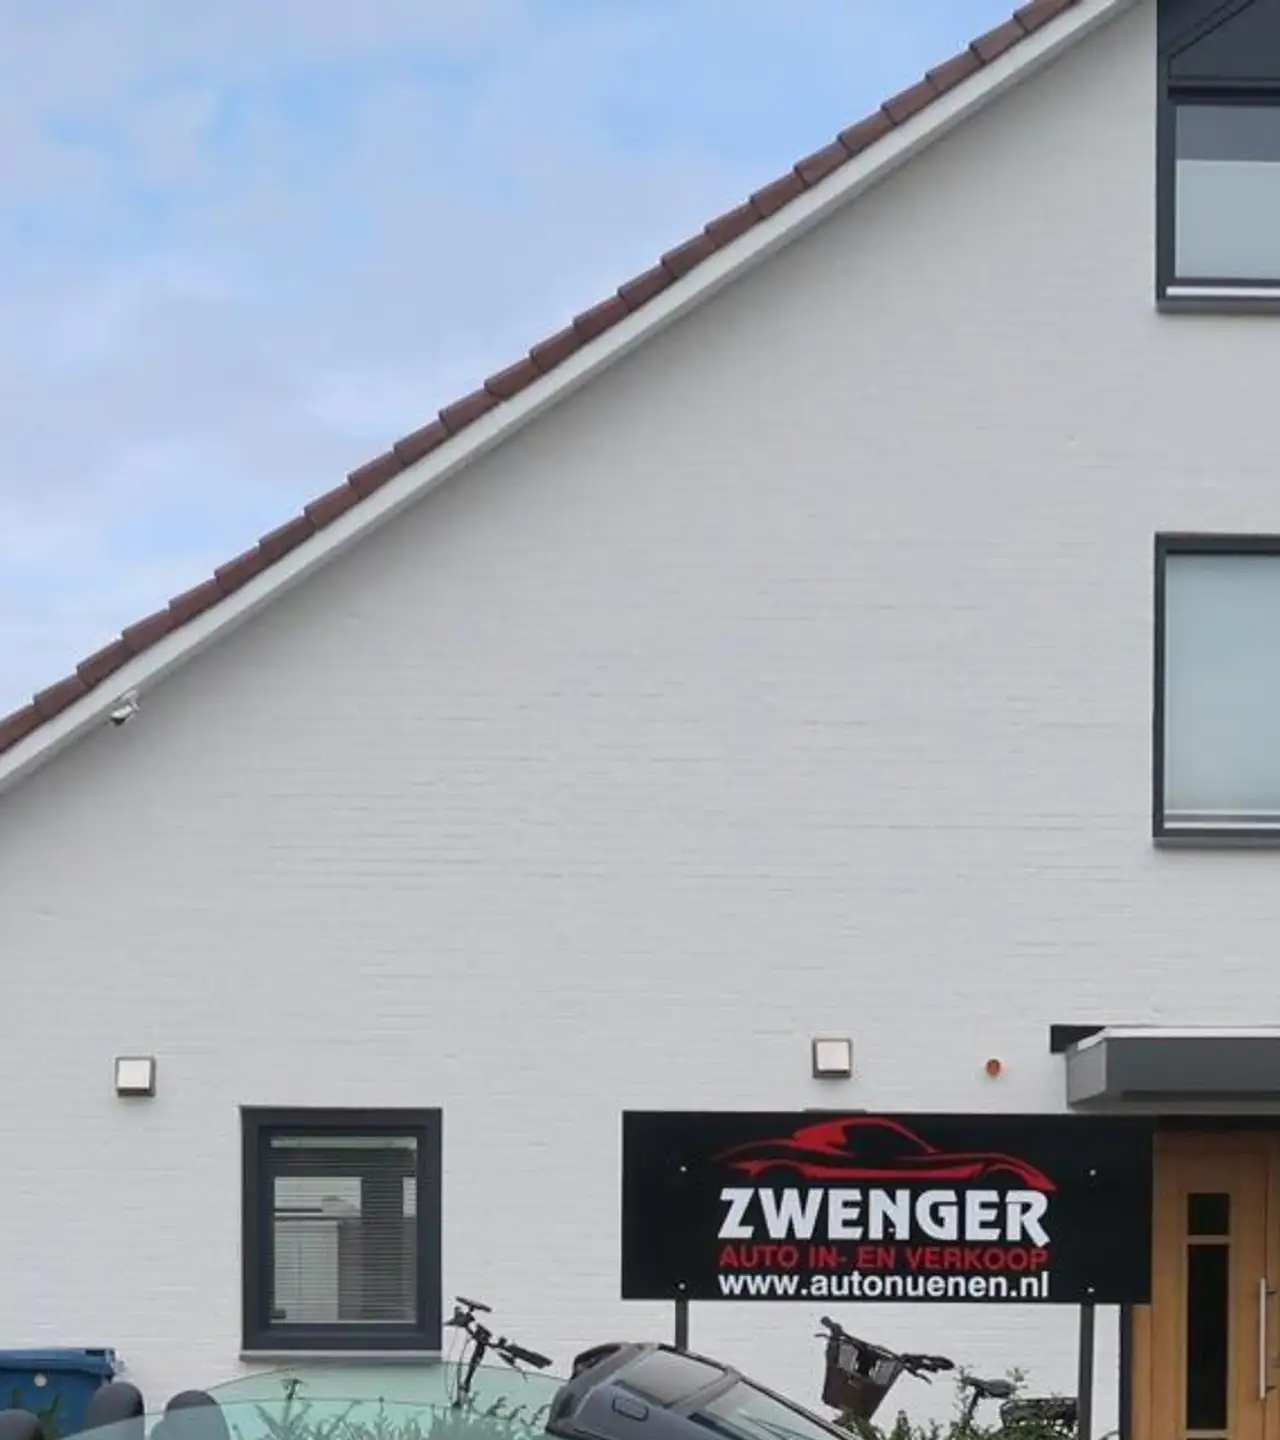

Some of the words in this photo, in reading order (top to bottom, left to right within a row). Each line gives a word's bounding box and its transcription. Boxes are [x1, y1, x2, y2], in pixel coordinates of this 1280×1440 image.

[718, 1188, 1050, 1247] ZWENGER
[721, 1244, 799, 1268] AUTO
[809, 1245, 846, 1268] IN-
[857, 1246, 895, 1269] EN
[907, 1247, 1048, 1270] VERKOOP
[718, 1270, 1049, 1298] www.autonuenen.nl
